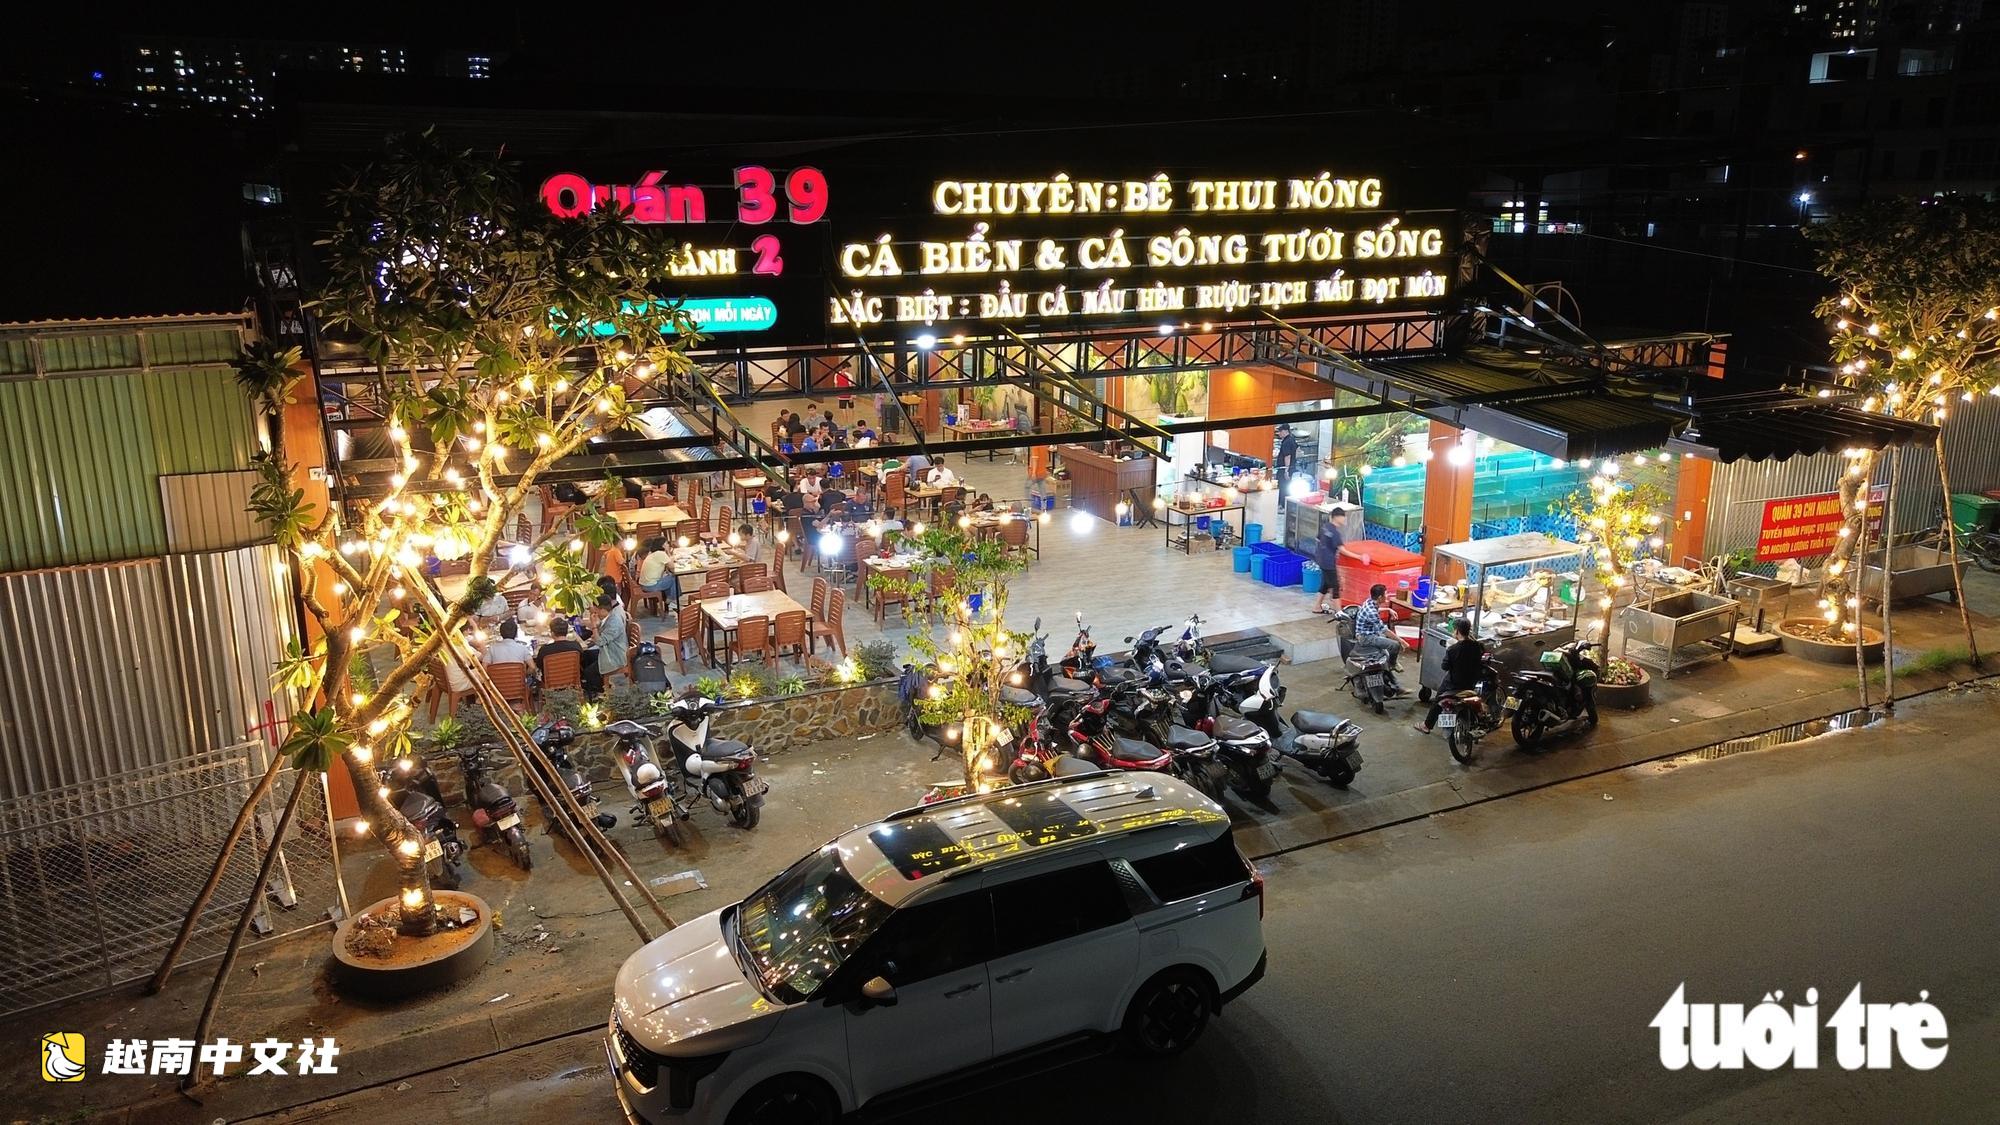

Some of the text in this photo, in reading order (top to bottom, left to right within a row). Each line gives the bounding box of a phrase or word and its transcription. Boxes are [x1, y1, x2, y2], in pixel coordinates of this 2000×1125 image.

[540, 165, 829, 224] Quán 39
[1188, 180, 1278, 211] THUI
[1288, 171, 1383, 209] NÓNG
[752, 234, 784, 276] 2
[841, 217, 1443, 277] CÁ BIỂN & CÁ SÔNG TƯƠI SỐNG
[896, 288, 953, 327] BIỆT
[1038, 283, 1070, 315] CÁ
[1081, 278, 1126, 314] NẤU
[1405, 269, 1447, 298] MÔN
[1771, 502, 1793, 523] QUÁN
[1793, 503, 1803, 518] 39
